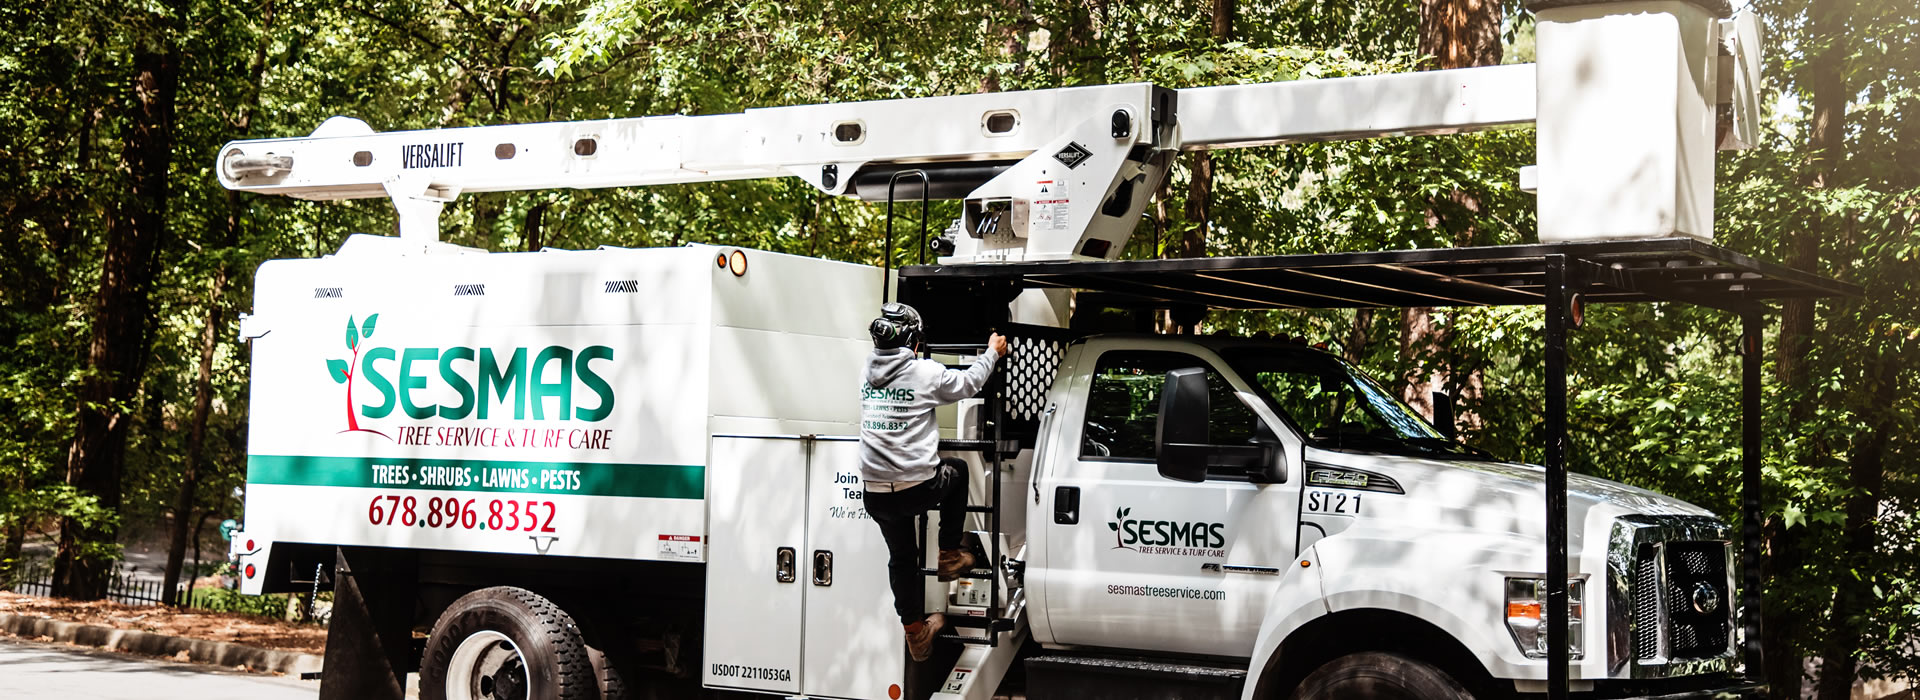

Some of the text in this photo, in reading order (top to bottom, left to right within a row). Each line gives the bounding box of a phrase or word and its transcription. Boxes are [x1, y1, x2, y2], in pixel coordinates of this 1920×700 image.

[402, 142, 464, 169] VERSALIFT
[361, 345, 615, 422] SESMAS
[864, 387, 915, 401] SESMAS
[397, 426, 613, 450] TREE SERVICE & TURF CARE
[371, 464, 581, 490] TREES SHRUBS LAWNS PESTS
[834, 472, 859, 484] Join
[843, 488, 862, 500] Tea
[369, 495, 556, 533] 678.896.8352
[829, 506, 857, 519] We're
[1122, 519, 1225, 548] SESMAS
[1139, 546, 1225, 558] TREE SERVICE & TURF CARE
[1107, 584, 1226, 601] sesmastreeservice.com
[712, 663, 791, 682] USDOT 2211053GA
